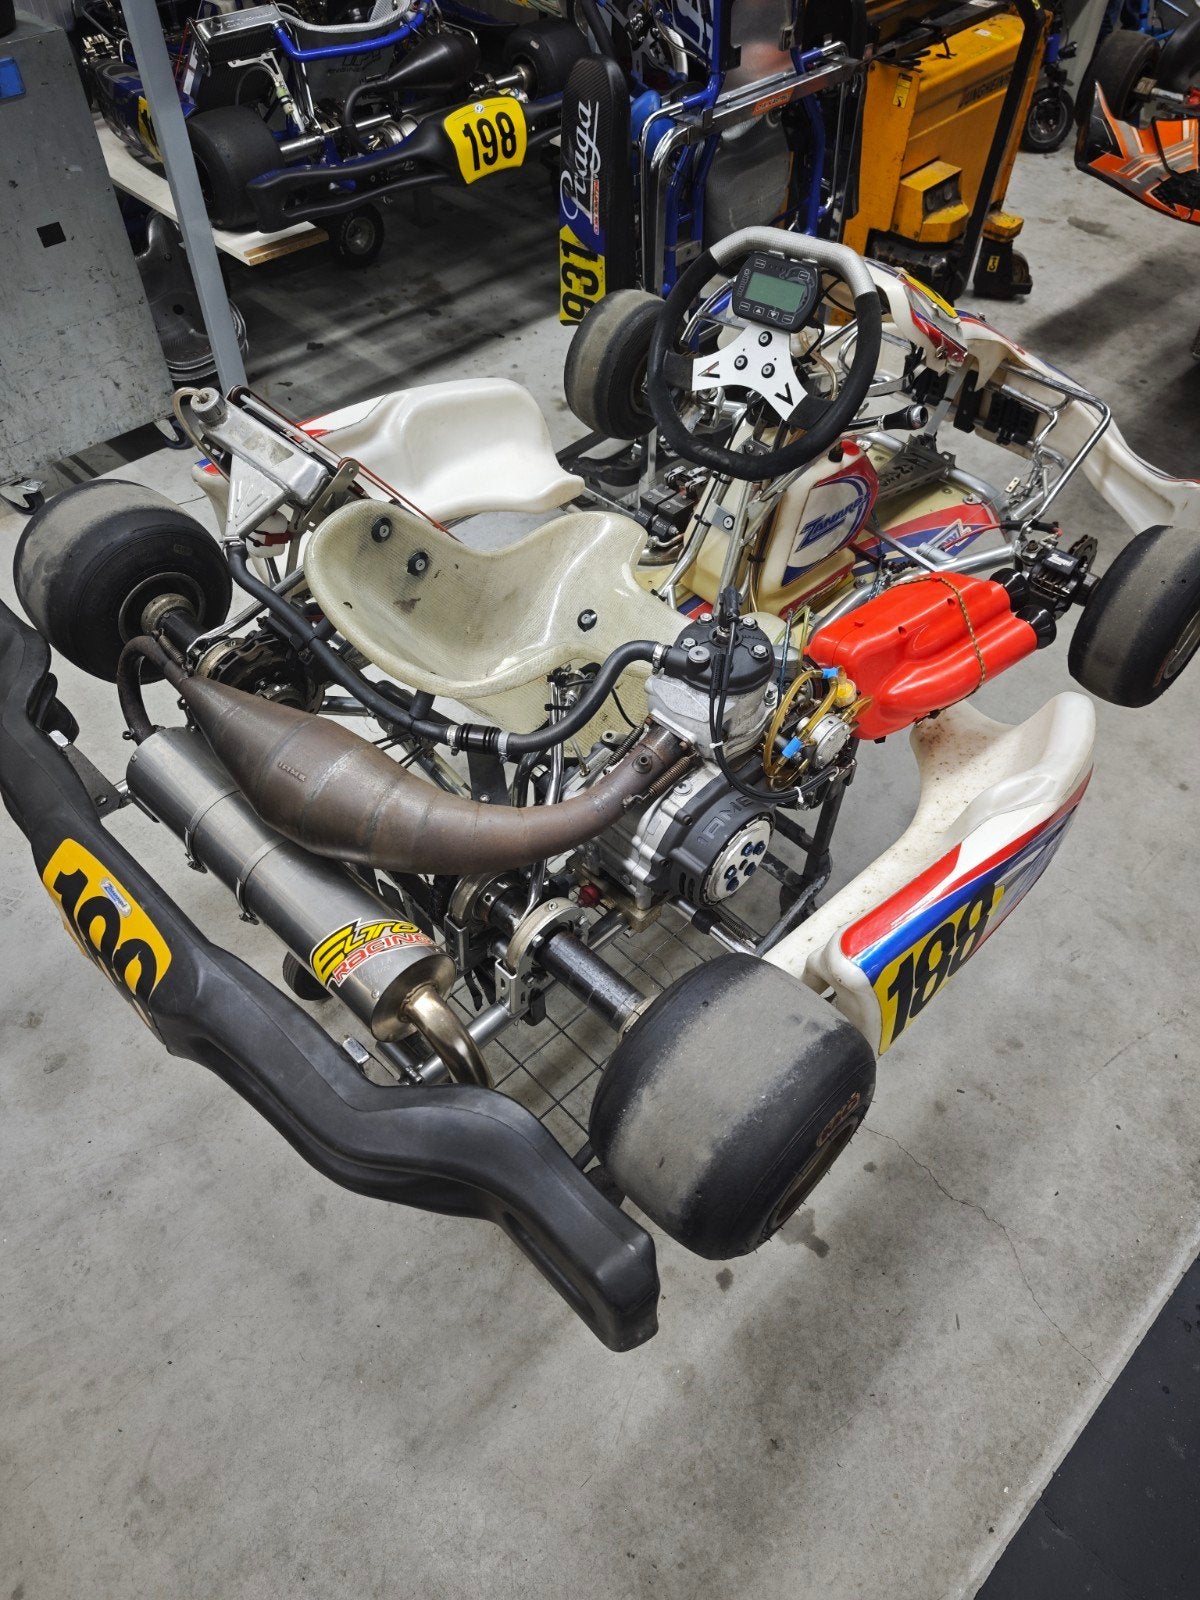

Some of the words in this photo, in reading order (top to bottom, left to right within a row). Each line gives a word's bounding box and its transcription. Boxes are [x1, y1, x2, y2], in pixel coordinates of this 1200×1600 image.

[463, 111, 517, 171] 198
[559, 100, 600, 224] Praga
[561, 239, 599, 321] 931
[697, 795, 755, 848] IAME
[310, 917, 421, 987] ELTO
[332, 931, 437, 986] RACING
[887, 882, 996, 1046] 188
